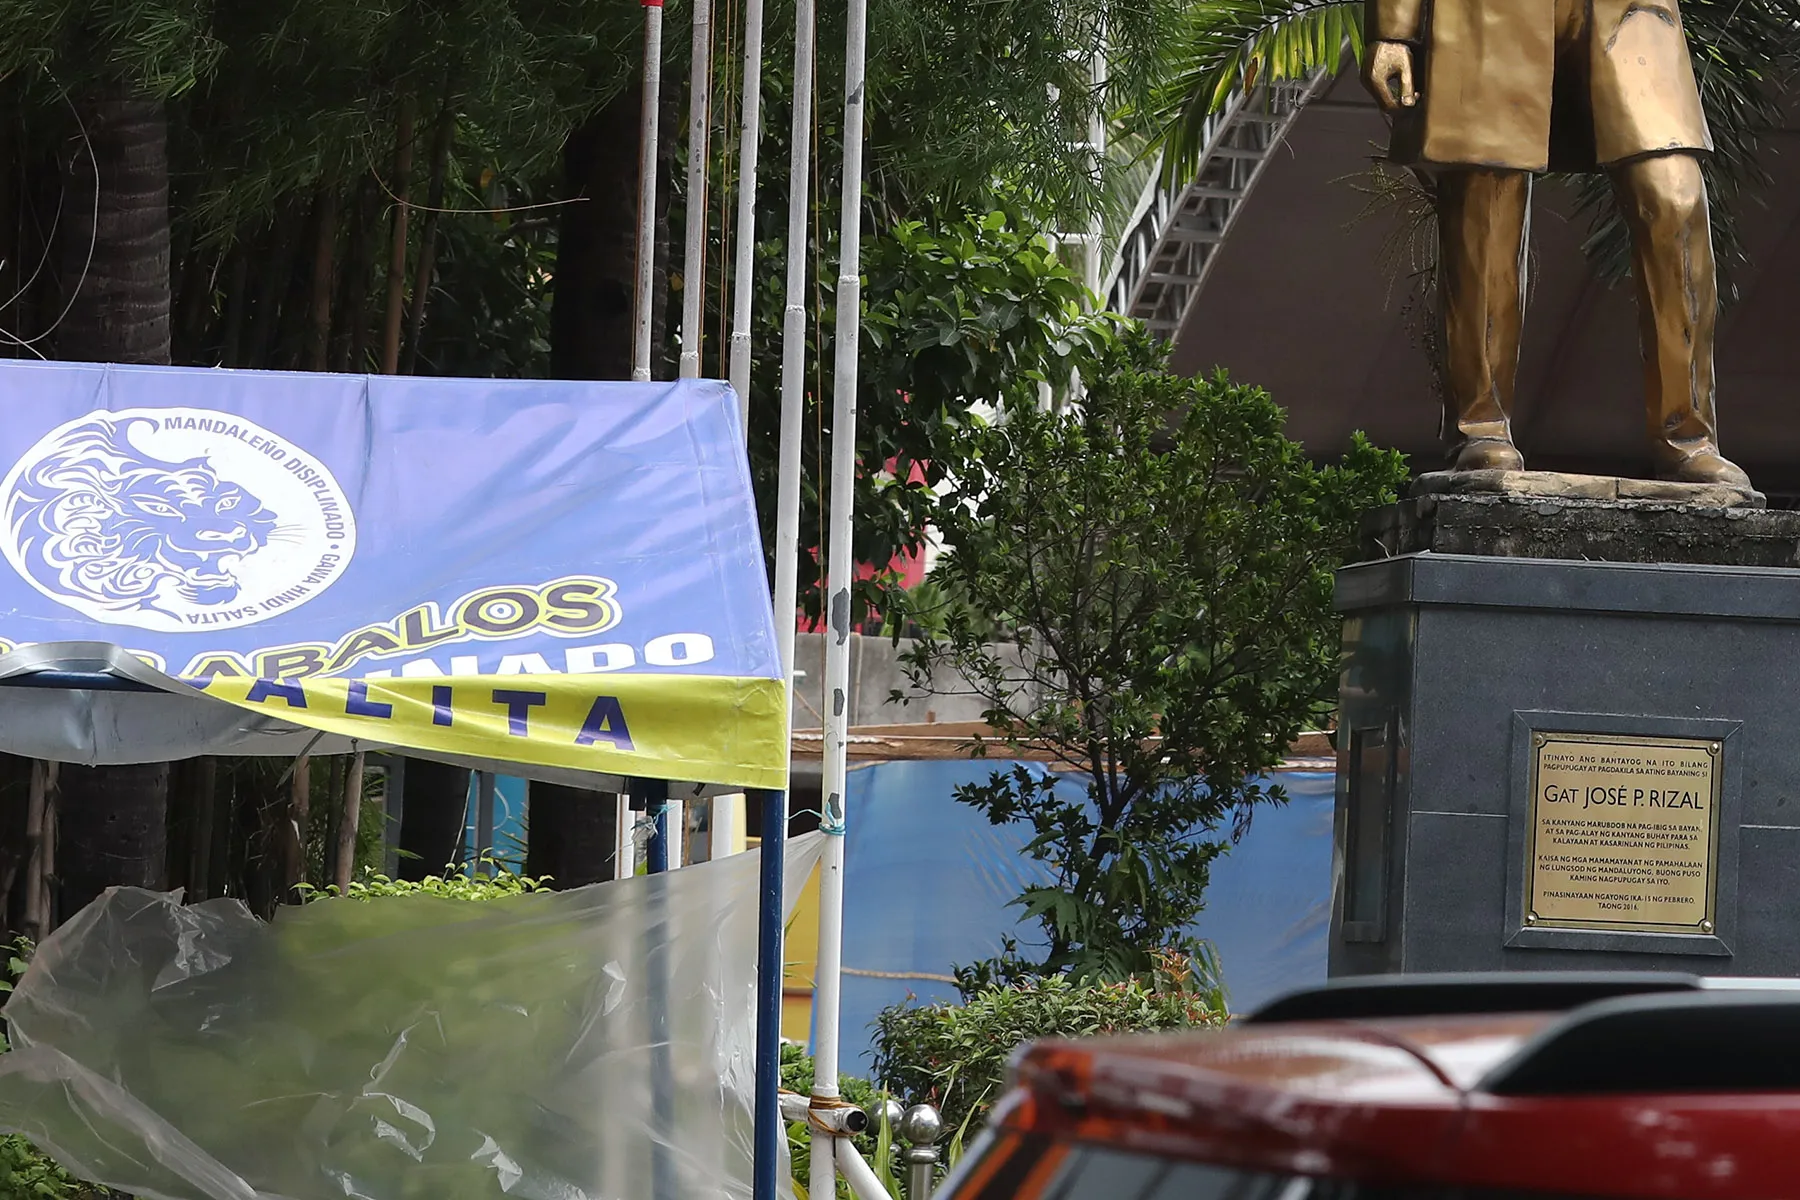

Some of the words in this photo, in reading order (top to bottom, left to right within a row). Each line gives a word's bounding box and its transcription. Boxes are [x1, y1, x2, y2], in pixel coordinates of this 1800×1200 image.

[165, 417, 287, 461] MANDALEÑO
[284, 458, 345, 539] DISIPLINADO
[303, 554, 340, 583] GAWA
[264, 584, 311, 612] HINDI
[186, 606, 258, 625] SALITA
[182, 675, 635, 751] ALITA
[1601, 757, 1641, 765] BANTAYOG
[1583, 785, 1627, 809] JOSÉ
[1634, 790, 1644, 806] P.
[1650, 790, 1704, 809] RIZAL
